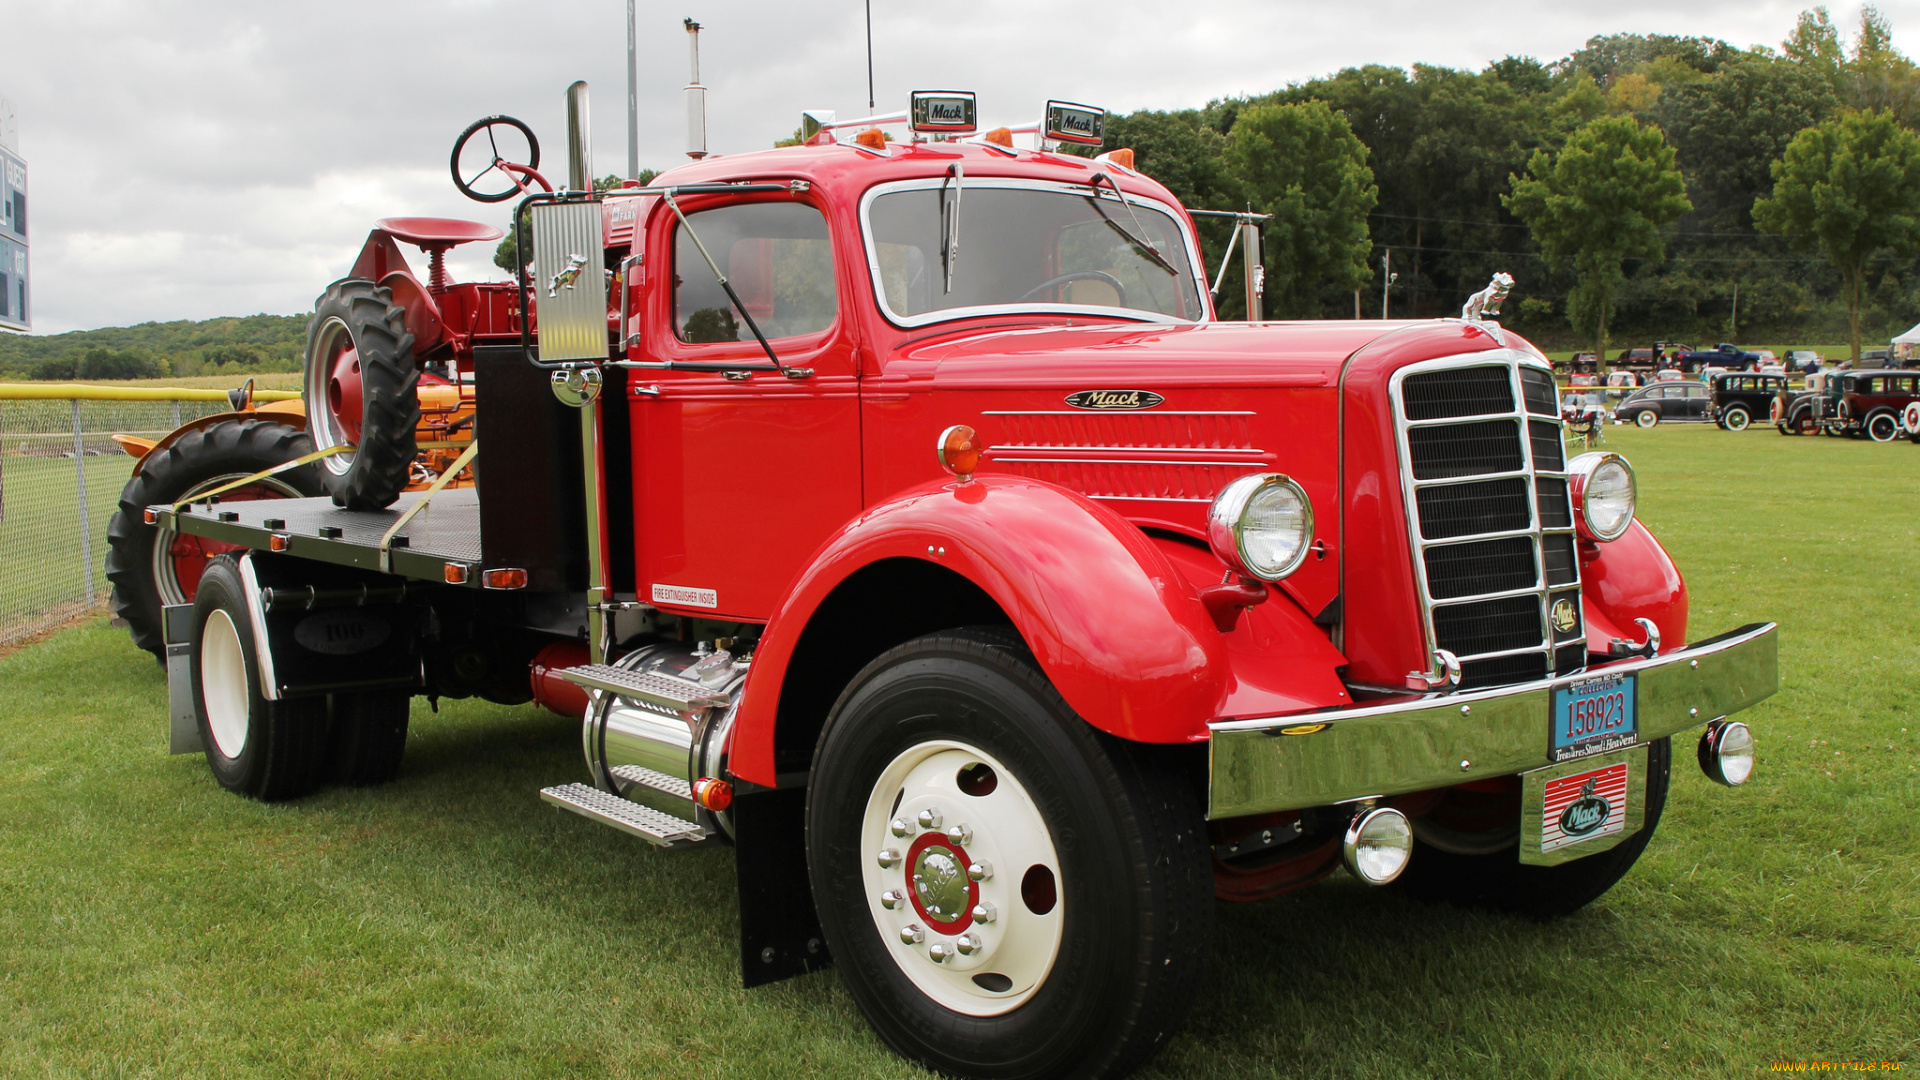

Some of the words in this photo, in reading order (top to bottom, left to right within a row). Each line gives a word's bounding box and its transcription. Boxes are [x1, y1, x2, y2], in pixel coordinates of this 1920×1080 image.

[931, 104, 963, 120] Mack
[1063, 115, 1091, 131] Mack
[7, 161, 26, 192] GUEST
[1085, 391, 1140, 408] Mack
[654, 587, 665, 599] FIRE
[665, 589, 697, 603] EXTINGUISHER
[698, 593, 715, 605] INSIDE
[1556, 604, 1575, 631] Mack
[1579, 681, 1615, 695] COLLECTOR
[1567, 691, 1625, 738] 158923
[1566, 803, 1602, 831] Mack
